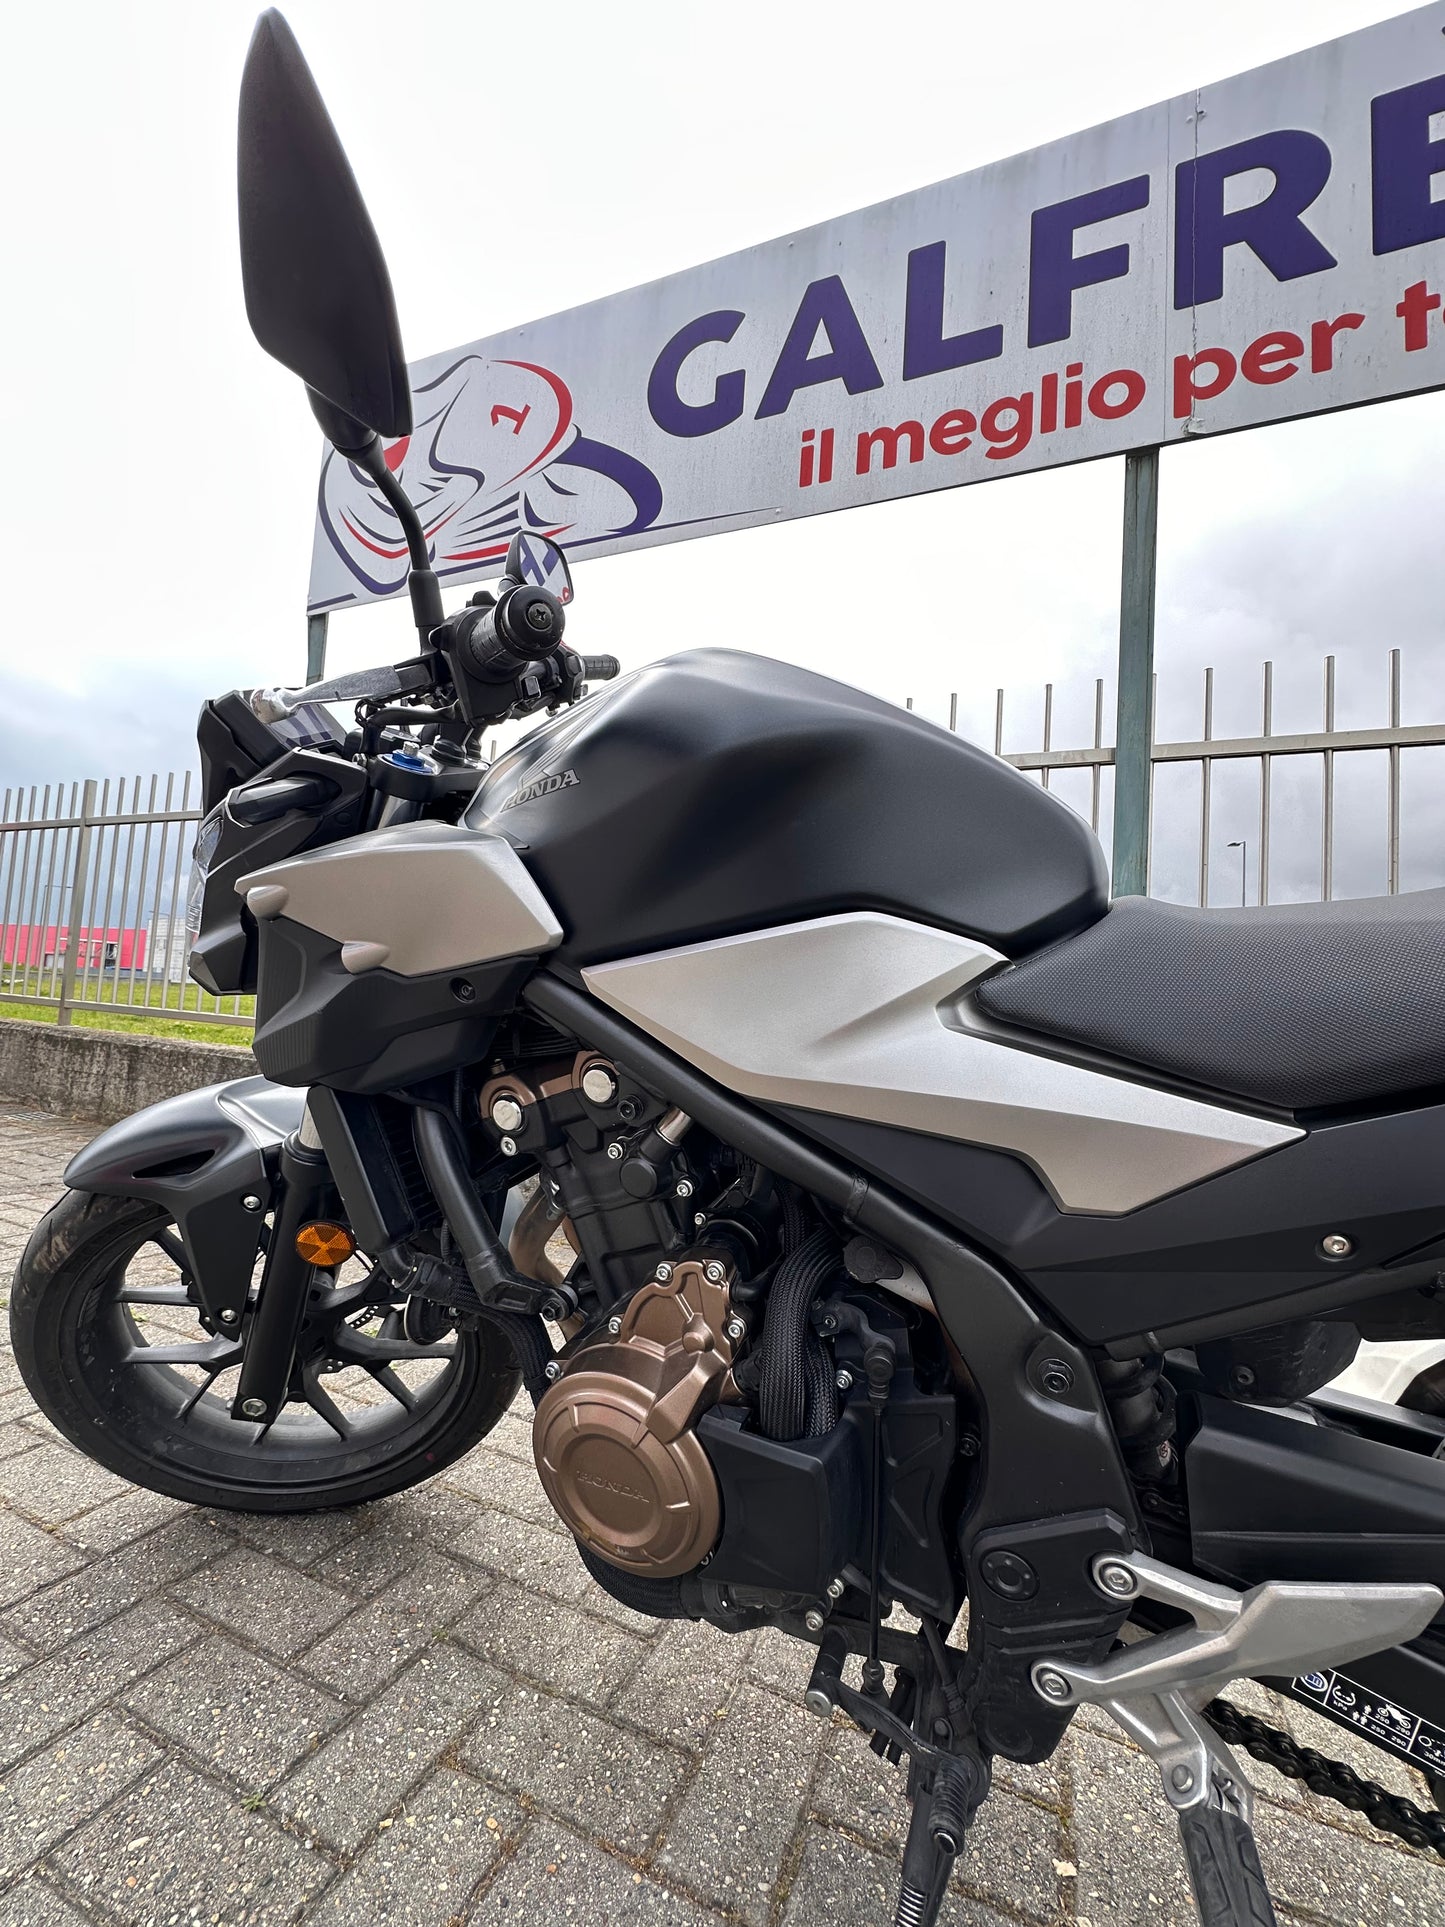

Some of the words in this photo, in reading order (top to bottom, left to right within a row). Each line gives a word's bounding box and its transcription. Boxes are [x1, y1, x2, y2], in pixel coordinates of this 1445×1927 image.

[799, 430, 834, 488] il
[856, 362, 1146, 460] meglio
[1173, 313, 1365, 419] per
[1396, 280, 1445, 352] t
[490, 404, 531, 436] 1
[503, 769, 580, 809] HONDA
[576, 1470, 650, 1504] HONDA
[1333, 1700, 1348, 1711] kPa
